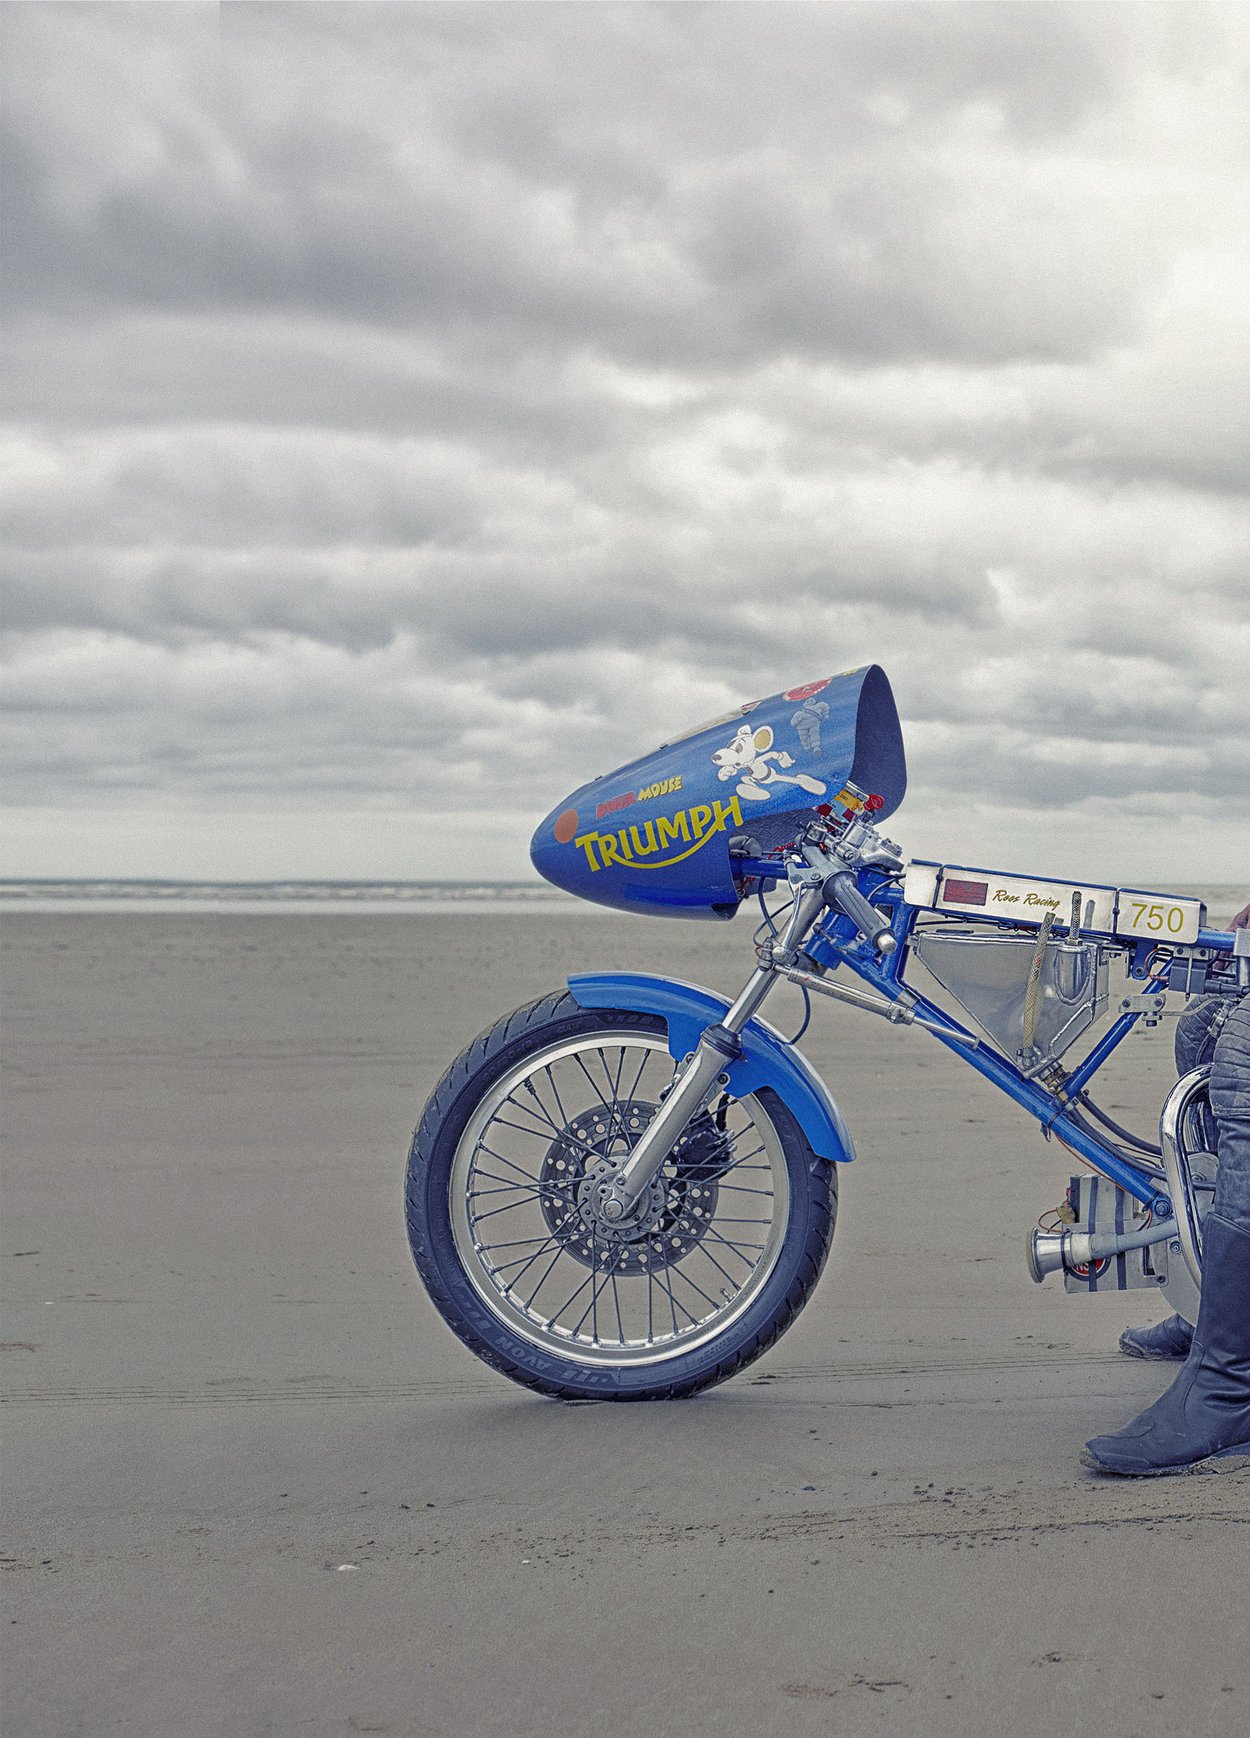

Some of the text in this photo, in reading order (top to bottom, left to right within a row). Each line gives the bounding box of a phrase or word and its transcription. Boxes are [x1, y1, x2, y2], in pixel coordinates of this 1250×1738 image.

[638, 776, 682, 802] MOUSE
[575, 795, 744, 872] TRIUMPH
[1023, 893, 1060, 911] Racing
[1132, 903, 1184, 933] 750
[495, 1336, 552, 1371] AVON
